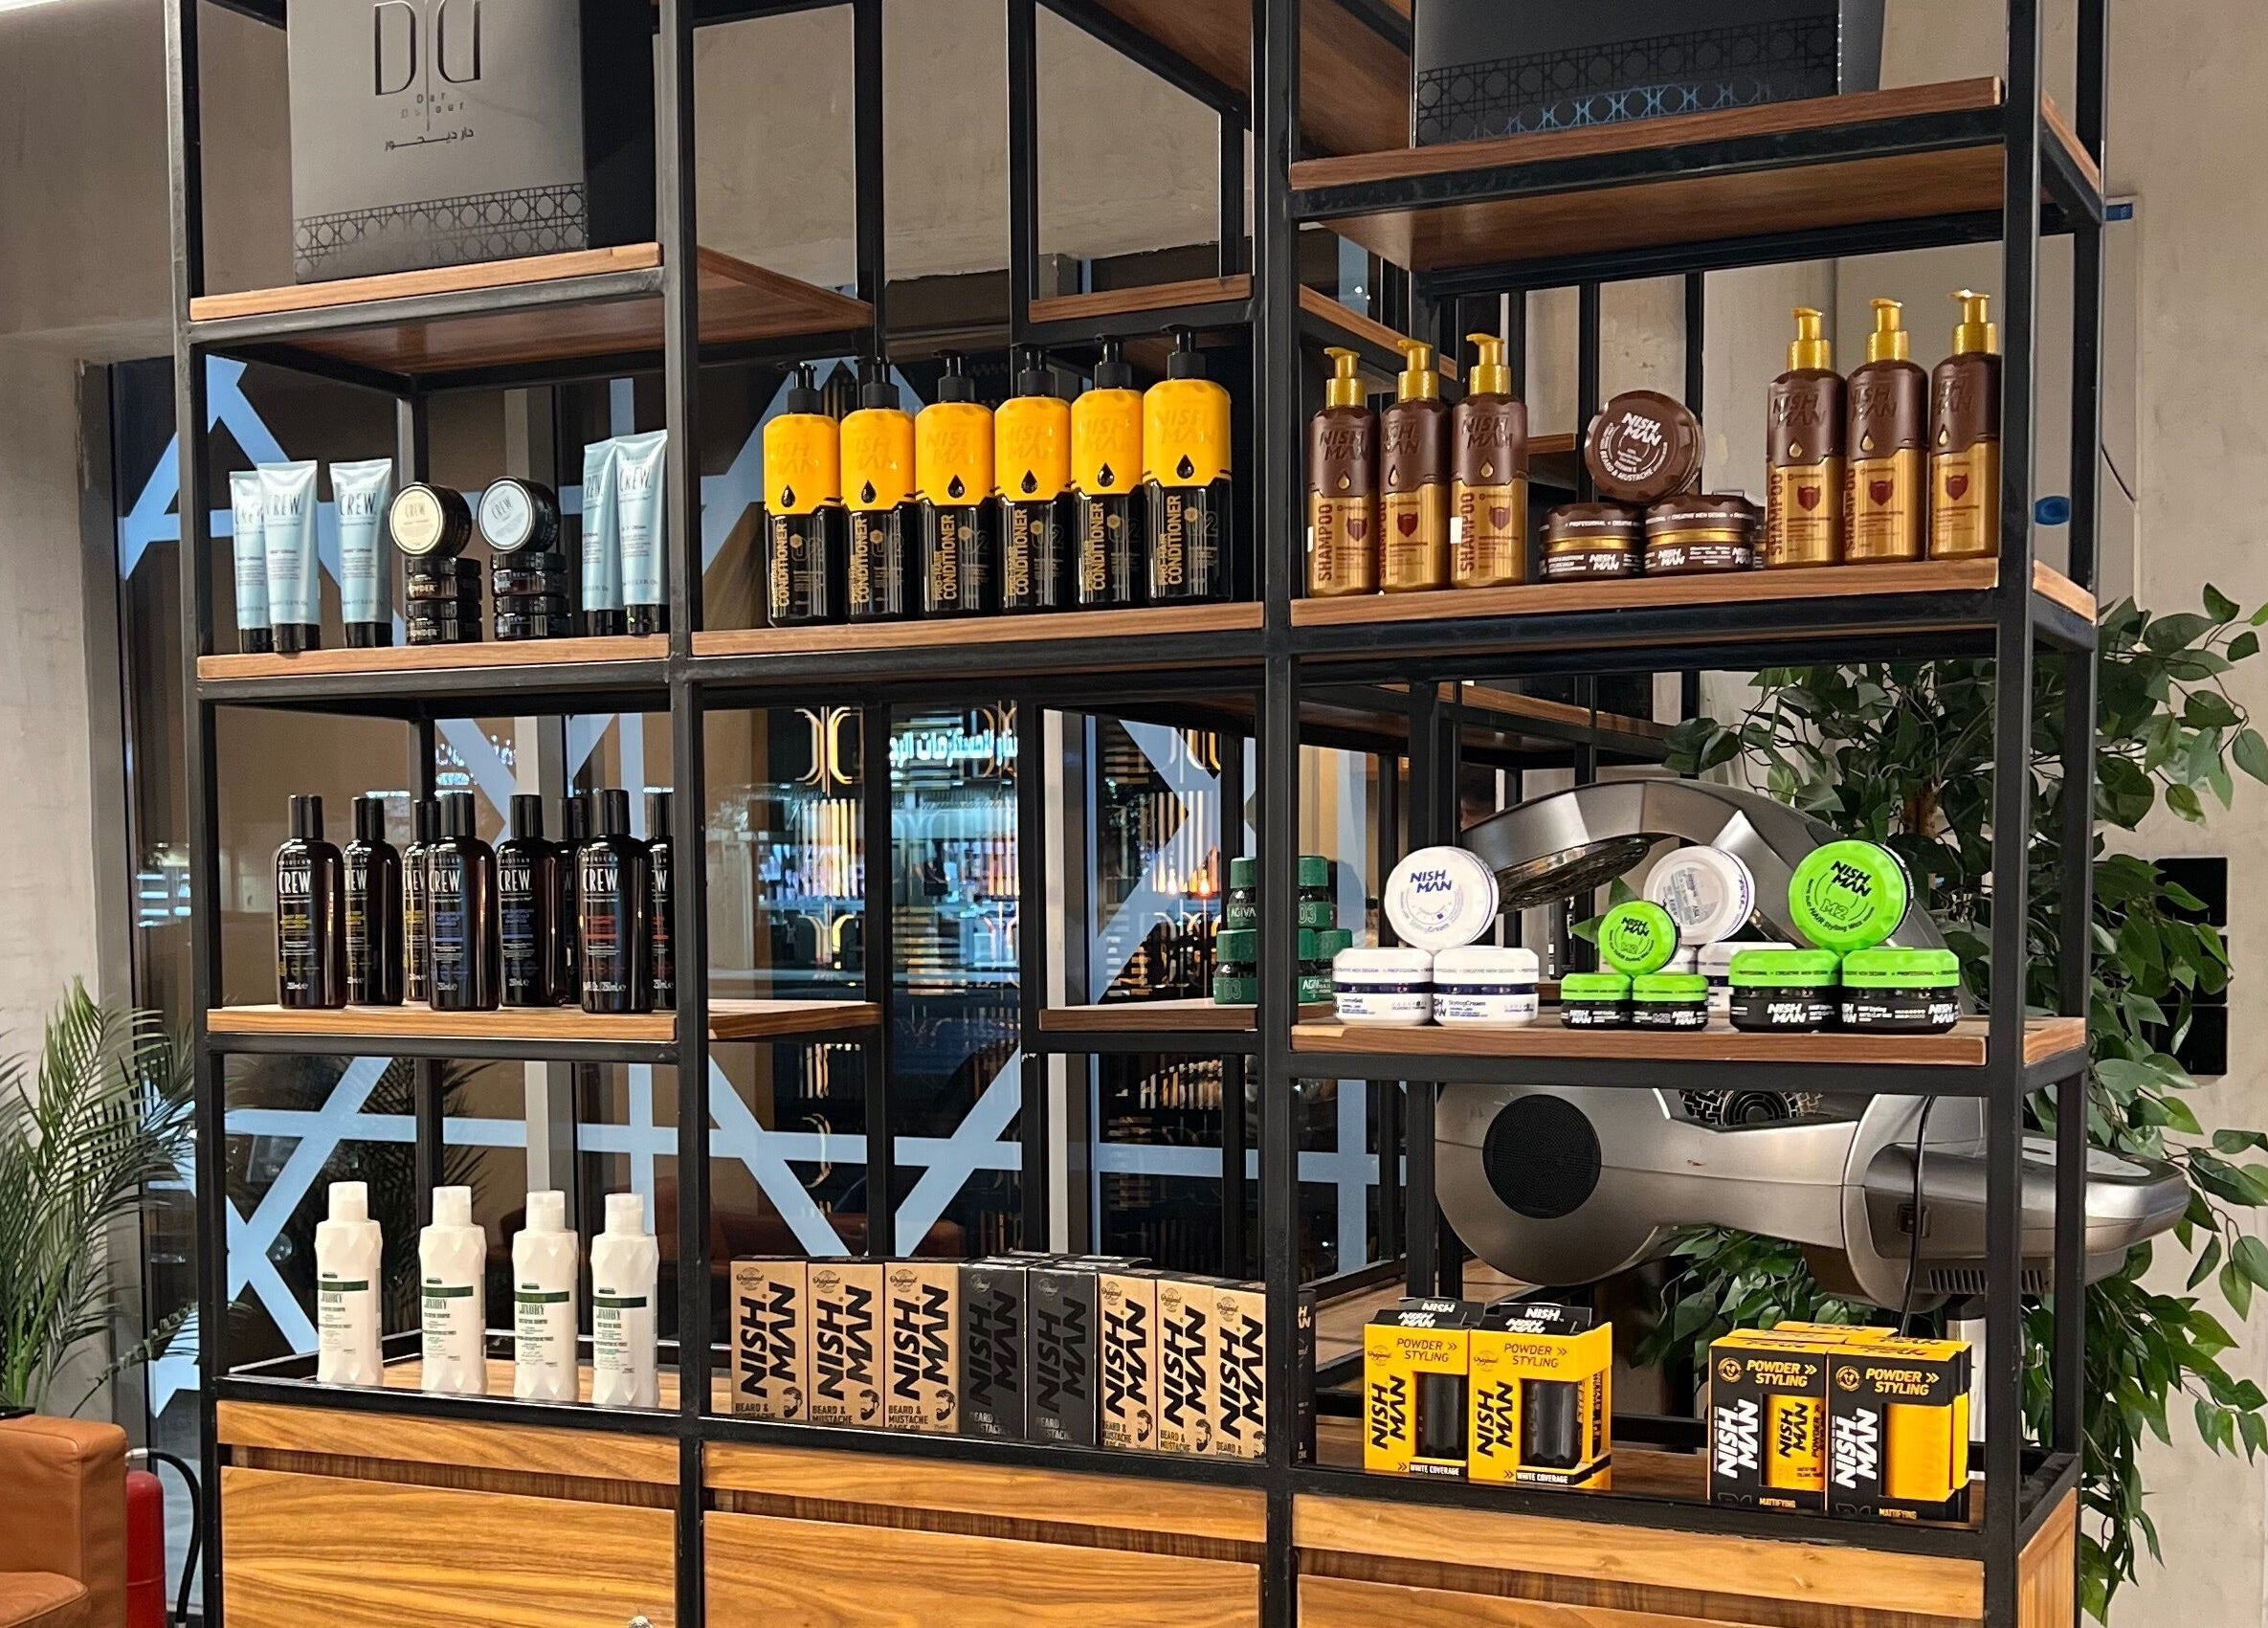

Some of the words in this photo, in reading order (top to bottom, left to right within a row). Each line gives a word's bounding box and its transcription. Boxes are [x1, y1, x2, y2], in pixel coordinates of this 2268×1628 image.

[1621, 413, 1661, 434] NISH
[1624, 426, 1662, 446] MAN
[620, 465, 651, 492] CREW
[340, 492, 376, 516] CREW
[1769, 474, 1783, 556] SHAMPOO
[1167, 495, 1183, 585] CONDITIONER
[1319, 503, 1333, 581] SHAMPOO
[1460, 492, 1475, 572] SHAMPOO
[941, 514, 957, 600] CONDITIONER
[1014, 508, 1029, 595] CONDITIONER
[1091, 502, 1105, 591] CONDITIONER
[1658, 548, 1682, 559] NISH
[1590, 553, 1616, 563] NISH
[1592, 561, 1620, 571] MAN
[1660, 556, 1685, 567] MAN
[278, 871, 312, 893] CREW
[345, 870, 367, 891] REW
[429, 870, 461, 892] CREW
[500, 869, 530, 891] CREW
[582, 868, 618, 892] CREW
[1410, 869, 1446, 882] NISH
[1831, 860, 1872, 884] NISH
[1416, 880, 1452, 893] MAN
[1832, 874, 1873, 897] MAN
[1230, 906, 1256, 918] AGIVA
[1819, 898, 1849, 921] M2
[1768, 1003, 1802, 1014] NISH
[1772, 1013, 1807, 1023] MAN
[1422, 1302, 1456, 1313] NISH
[1525, 1307, 1561, 1320] NISH
[768, 1282, 795, 1383] MAN
[1400, 1318, 1435, 1327] MAN
[846, 1284, 873, 1385] MAN
[922, 1283, 948, 1386] MAN
[993, 1289, 1017, 1393] MAN
[1397, 1338, 1443, 1350] POWDER
[740, 1296, 767, 1398] NISH
[817, 1299, 844, 1401] NISH
[894, 1298, 920, 1401] NISH
[968, 1303, 992, 1407] NISH
[1062, 1296, 1086, 1401] MAN
[1125, 1298, 1146, 1406] MAN
[1405, 1349, 1450, 1363] STYLING
[1504, 1343, 1552, 1355] POWDER
[1037, 1308, 1061, 1414] NISH
[1104, 1310, 1124, 1418] NISH
[1185, 1305, 1206, 1415] MAN
[1242, 1314, 1263, 1427] MAN
[1512, 1355, 1559, 1368] STYLING
[1746, 1359, 1800, 1373] POWDER
[1164, 1317, 1184, 1429] NISH
[1220, 1327, 1241, 1439] NISH
[1755, 1372, 1808, 1387] STYLING
[1865, 1368, 1922, 1383] POWDER
[1874, 1381, 1929, 1395] STYLING
[735, 1403, 761, 1412] BEARD
[812, 1405, 837, 1414] BEARD
[888, 1405, 913, 1414] BEARD
[972, 1412, 993, 1423] EARD
[1371, 1382, 1389, 1450] NISH
[1390, 1374, 1406, 1441] MAN
[1496, 1381, 1513, 1448] MAN
[812, 1415, 853, 1424] MUSTACHE
[888, 1415, 928, 1424] MUSTACHE
[1038, 1417, 1061, 1429] EARD
[1122, 1424, 1127, 1433] &
[1477, 1389, 1494, 1458] NISH
[1792, 1402, 1808, 1452] MAN
[1161, 1429, 1180, 1440] BEARD
[1718, 1407, 1738, 1479] NISH
[1738, 1398, 1759, 1470] MAN
[1779, 1408, 1793, 1458] NISH
[1856, 1407, 1878, 1481] MAN
[1161, 1439, 1190, 1452] MUSTACHE
[1216, 1441, 1236, 1454] BEARD
[1236, 1446, 1242, 1455] &
[1835, 1415, 1857, 1488] NISH
[1410, 1464, 1428, 1473] WHITE
[1429, 1465, 1459, 1476] COVERAGE
[1517, 1472, 1536, 1481] WHITE
[1537, 1473, 1568, 1483] COVERAGE
[1759, 1498, 1796, 1508] MATTIFYING
